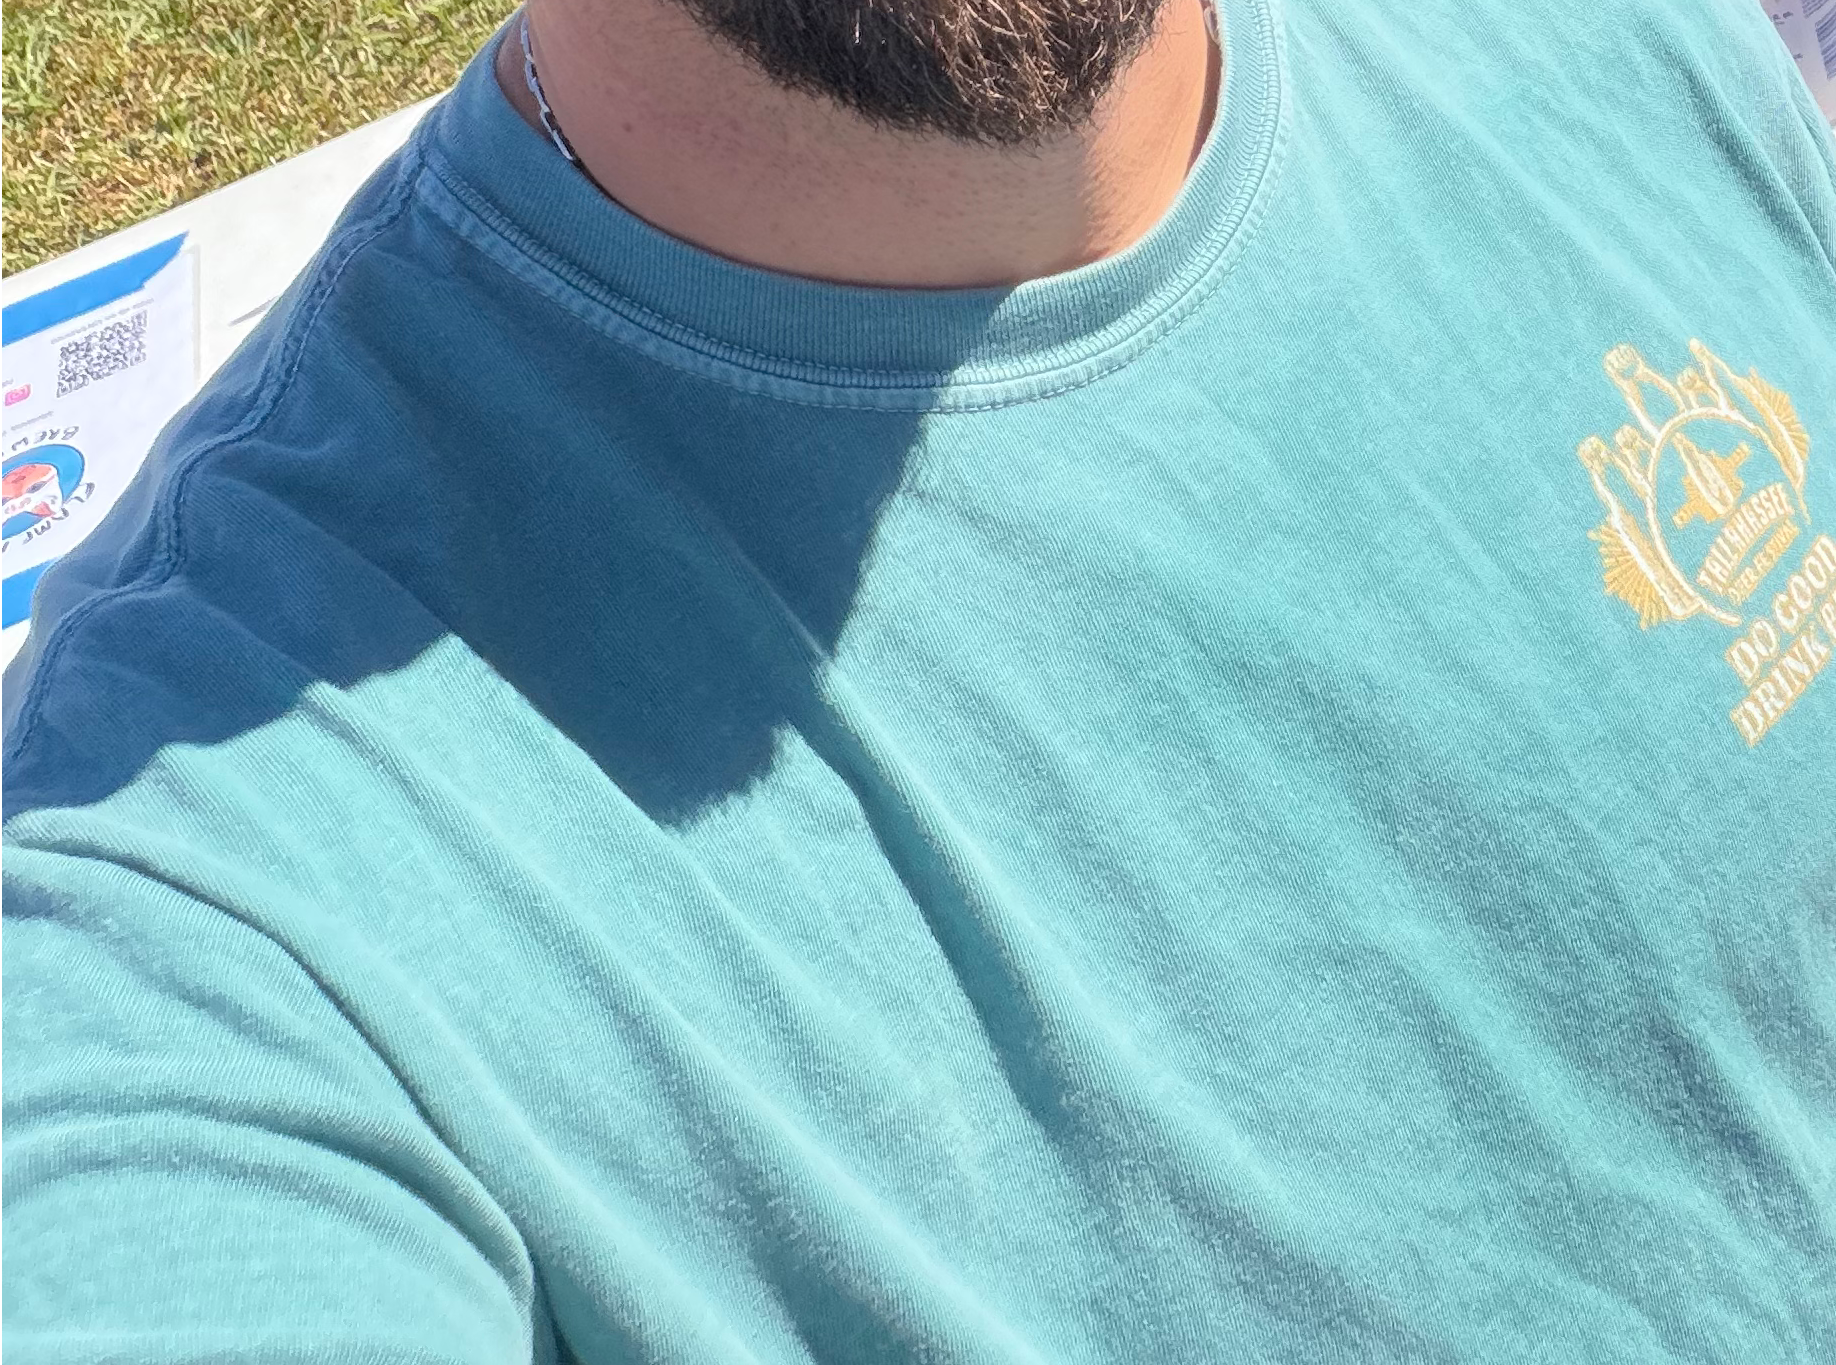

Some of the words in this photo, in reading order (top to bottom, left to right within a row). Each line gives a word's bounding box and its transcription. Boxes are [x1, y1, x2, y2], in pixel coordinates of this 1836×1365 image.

[1697, 481, 1795, 596] TALLAHASSEE
[1725, 616, 1780, 686] DO
[1730, 622, 1834, 748] DRINK
